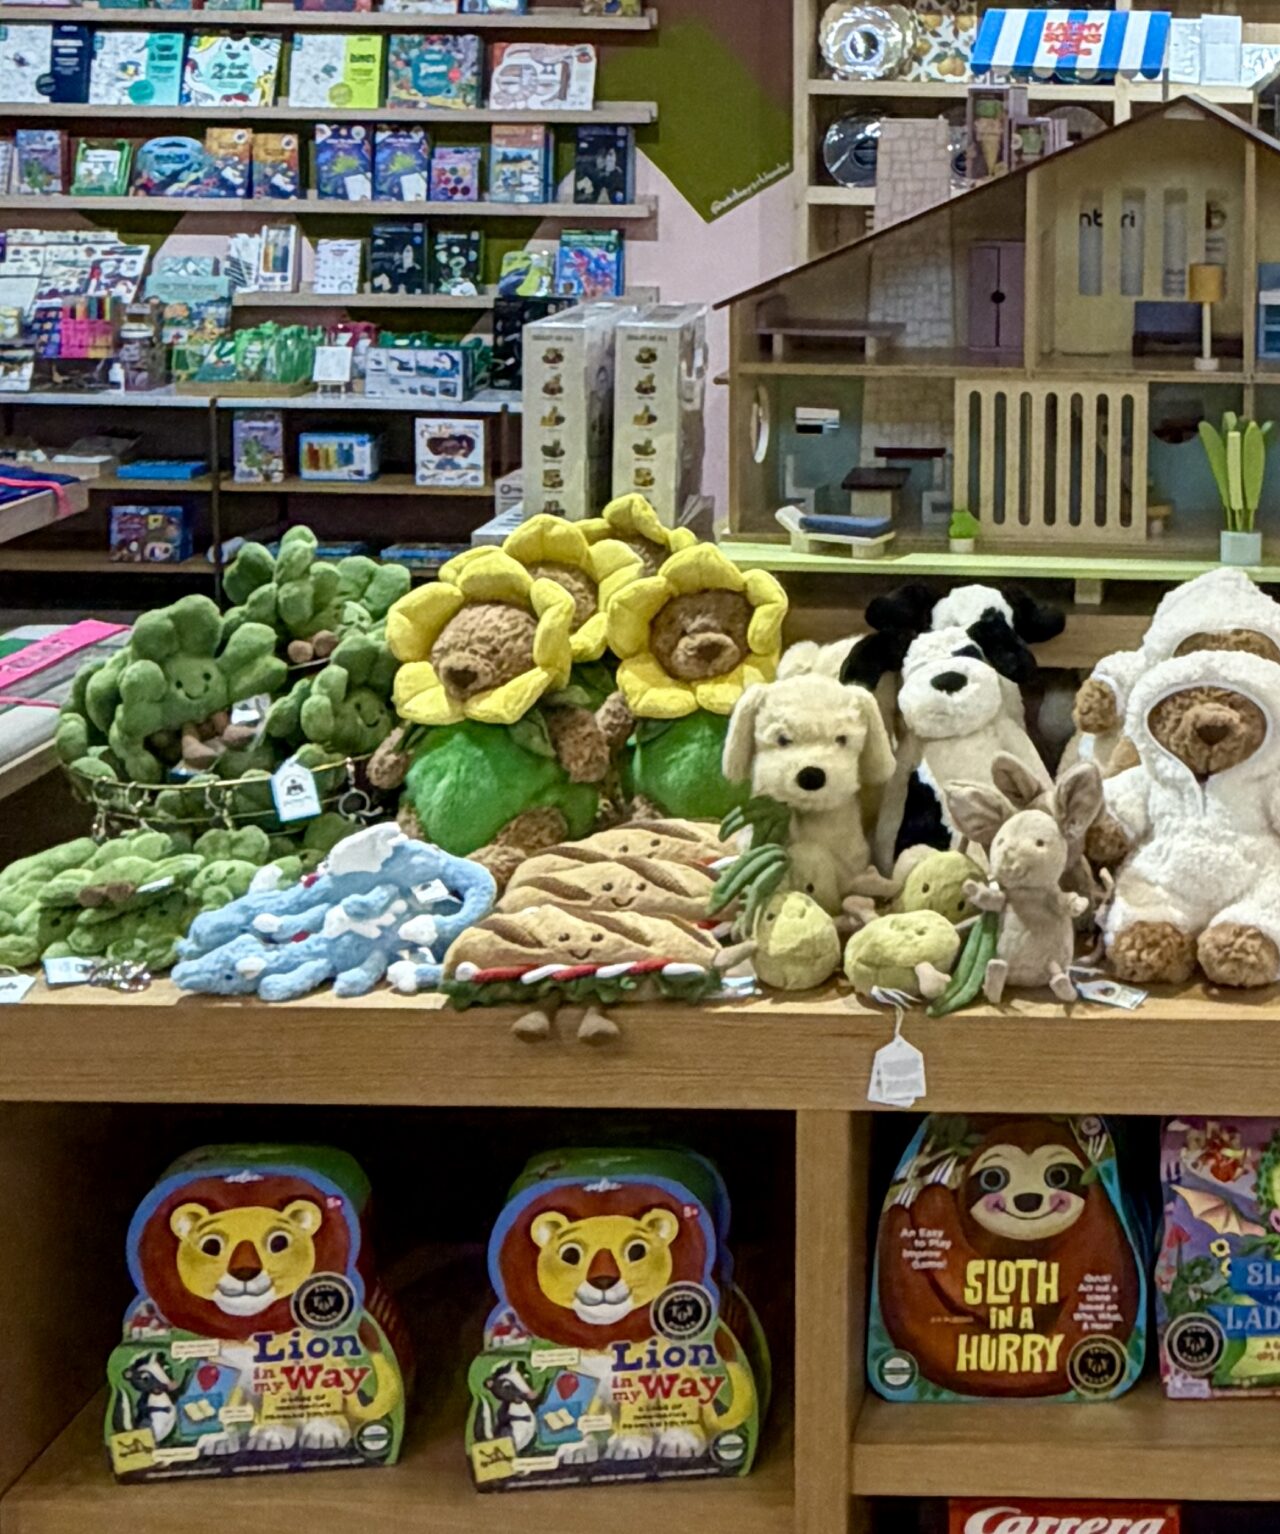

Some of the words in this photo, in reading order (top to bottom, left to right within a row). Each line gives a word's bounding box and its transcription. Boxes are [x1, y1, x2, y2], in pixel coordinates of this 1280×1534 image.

[964, 1258, 1060, 1306] SLOTH
[1019, 1306, 1034, 1330] A
[253, 1331, 362, 1363] Lion
[611, 1339, 718, 1372] Lion
[956, 1333, 1066, 1374] HURRY
[253, 1366, 275, 1380] in
[253, 1380, 284, 1395] my
[280, 1364, 371, 1395] Way
[612, 1375, 633, 1388] in
[612, 1391, 641, 1405] my
[638, 1373, 725, 1405] Way
[963, 1506, 1166, 1534] Carrera
